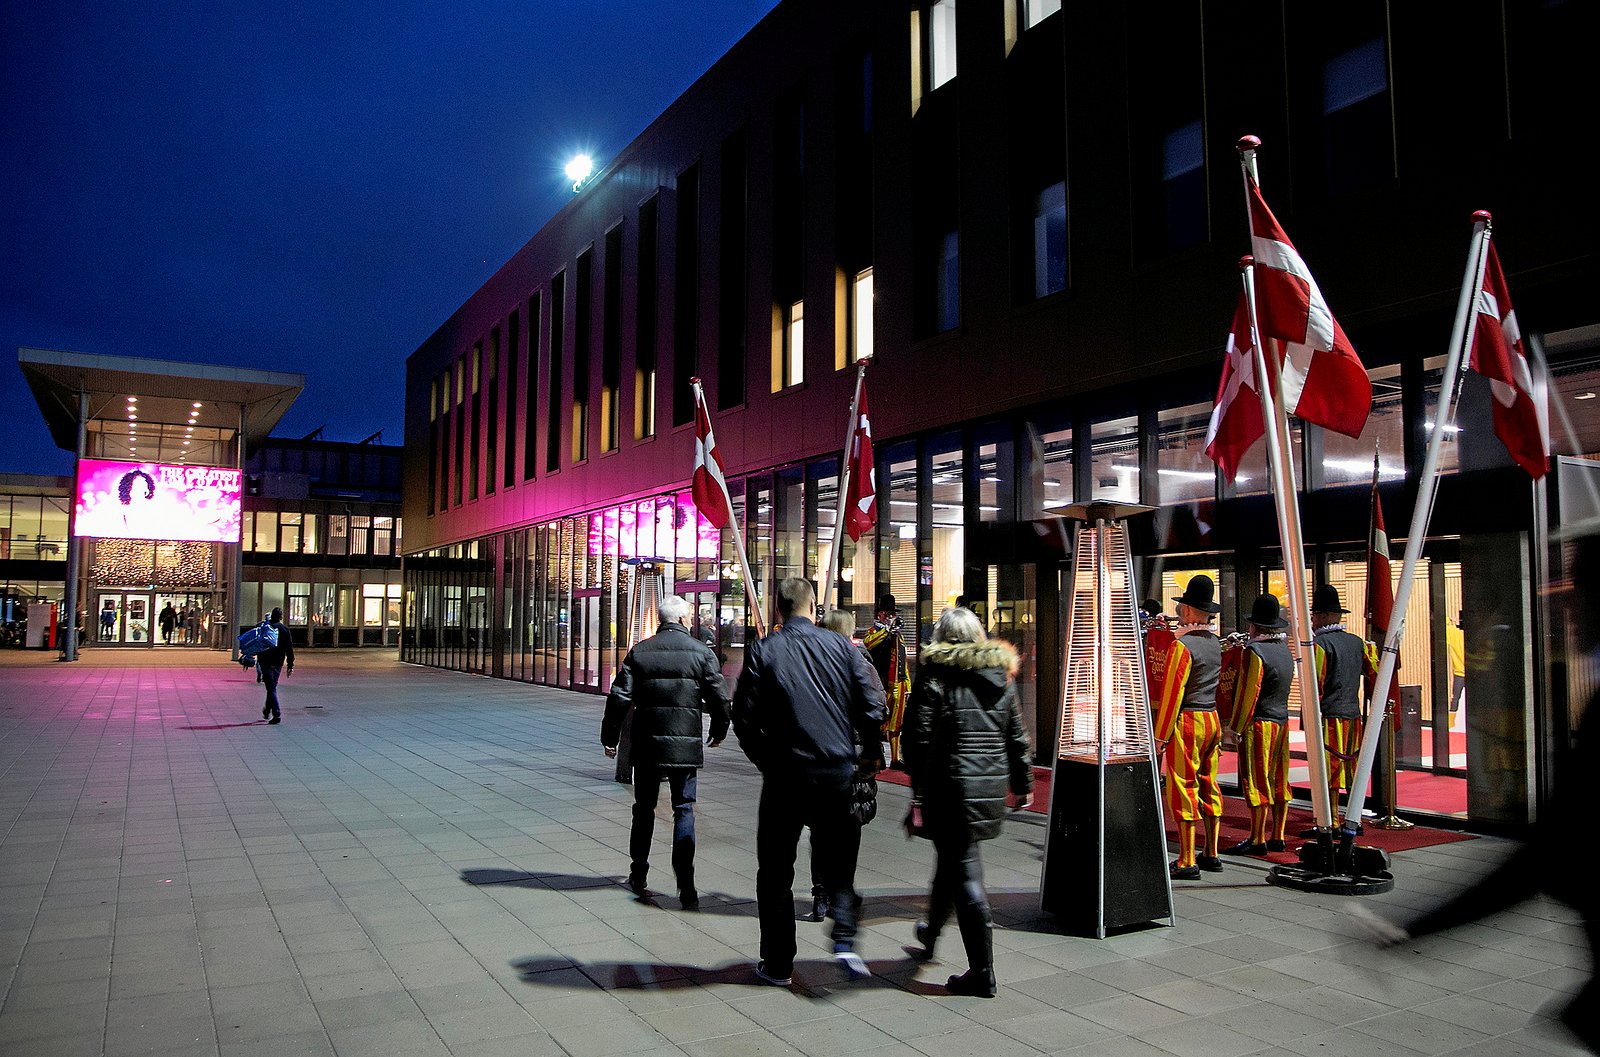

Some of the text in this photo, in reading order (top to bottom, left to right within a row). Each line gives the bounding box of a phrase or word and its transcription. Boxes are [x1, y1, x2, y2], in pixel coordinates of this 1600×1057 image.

[159, 467, 240, 480] THE GREATEST
[216, 480, 239, 492] ALL
